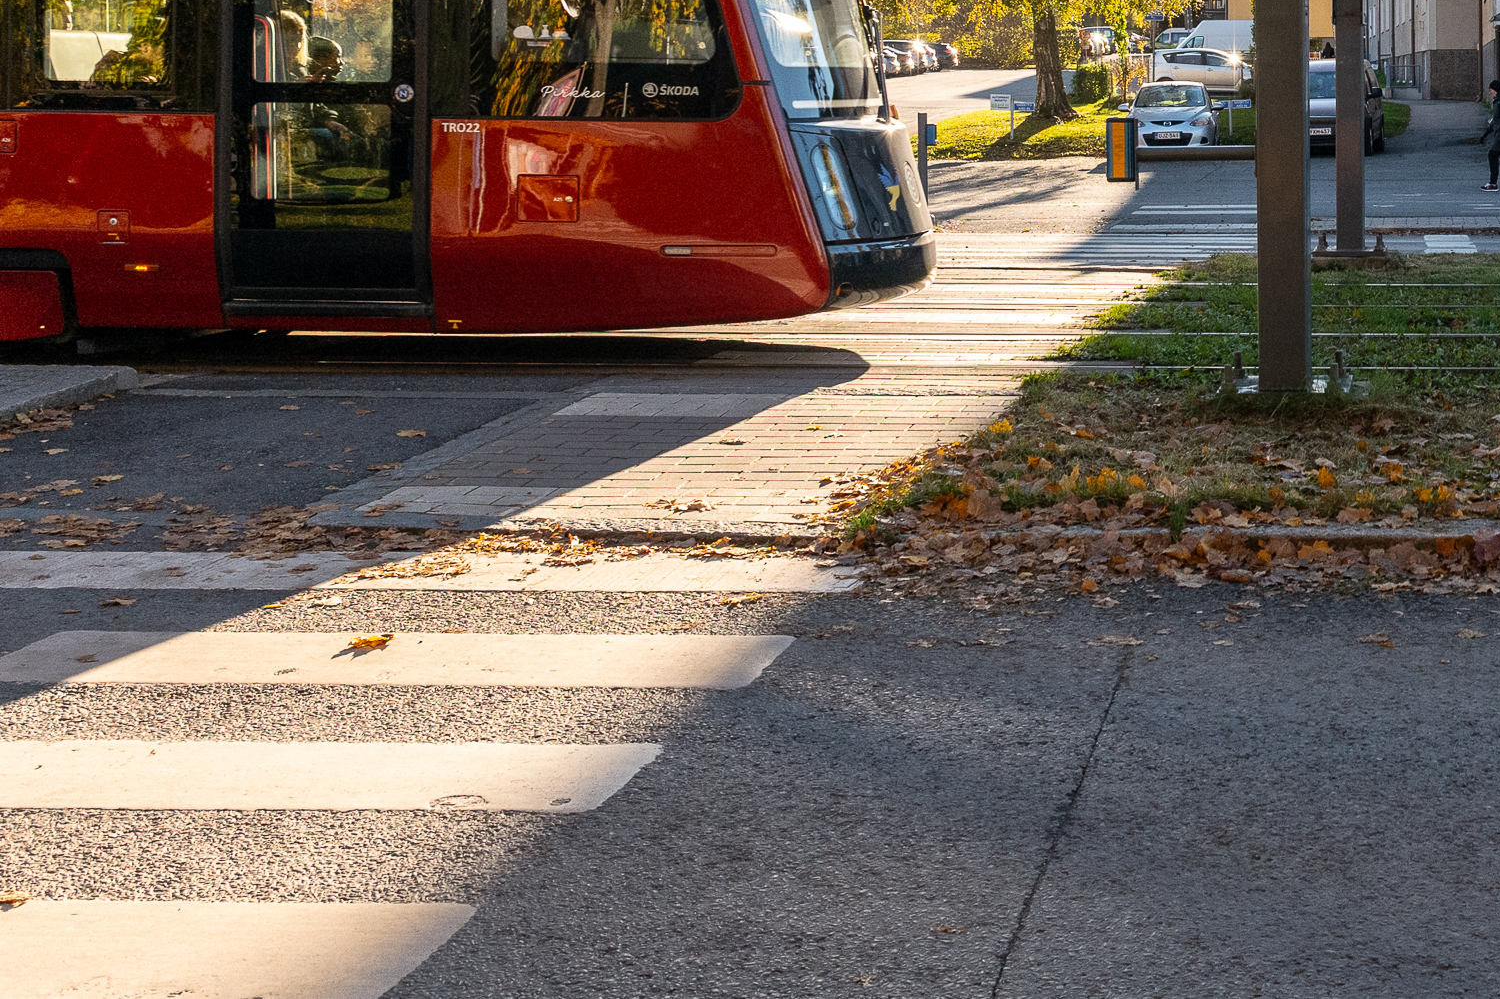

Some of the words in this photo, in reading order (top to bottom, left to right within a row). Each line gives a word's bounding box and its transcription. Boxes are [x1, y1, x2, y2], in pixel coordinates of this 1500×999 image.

[540, 85, 605, 98] Pirkka
[659, 84, 699, 96] ŠKODA
[441, 122, 480, 133] TRO22
